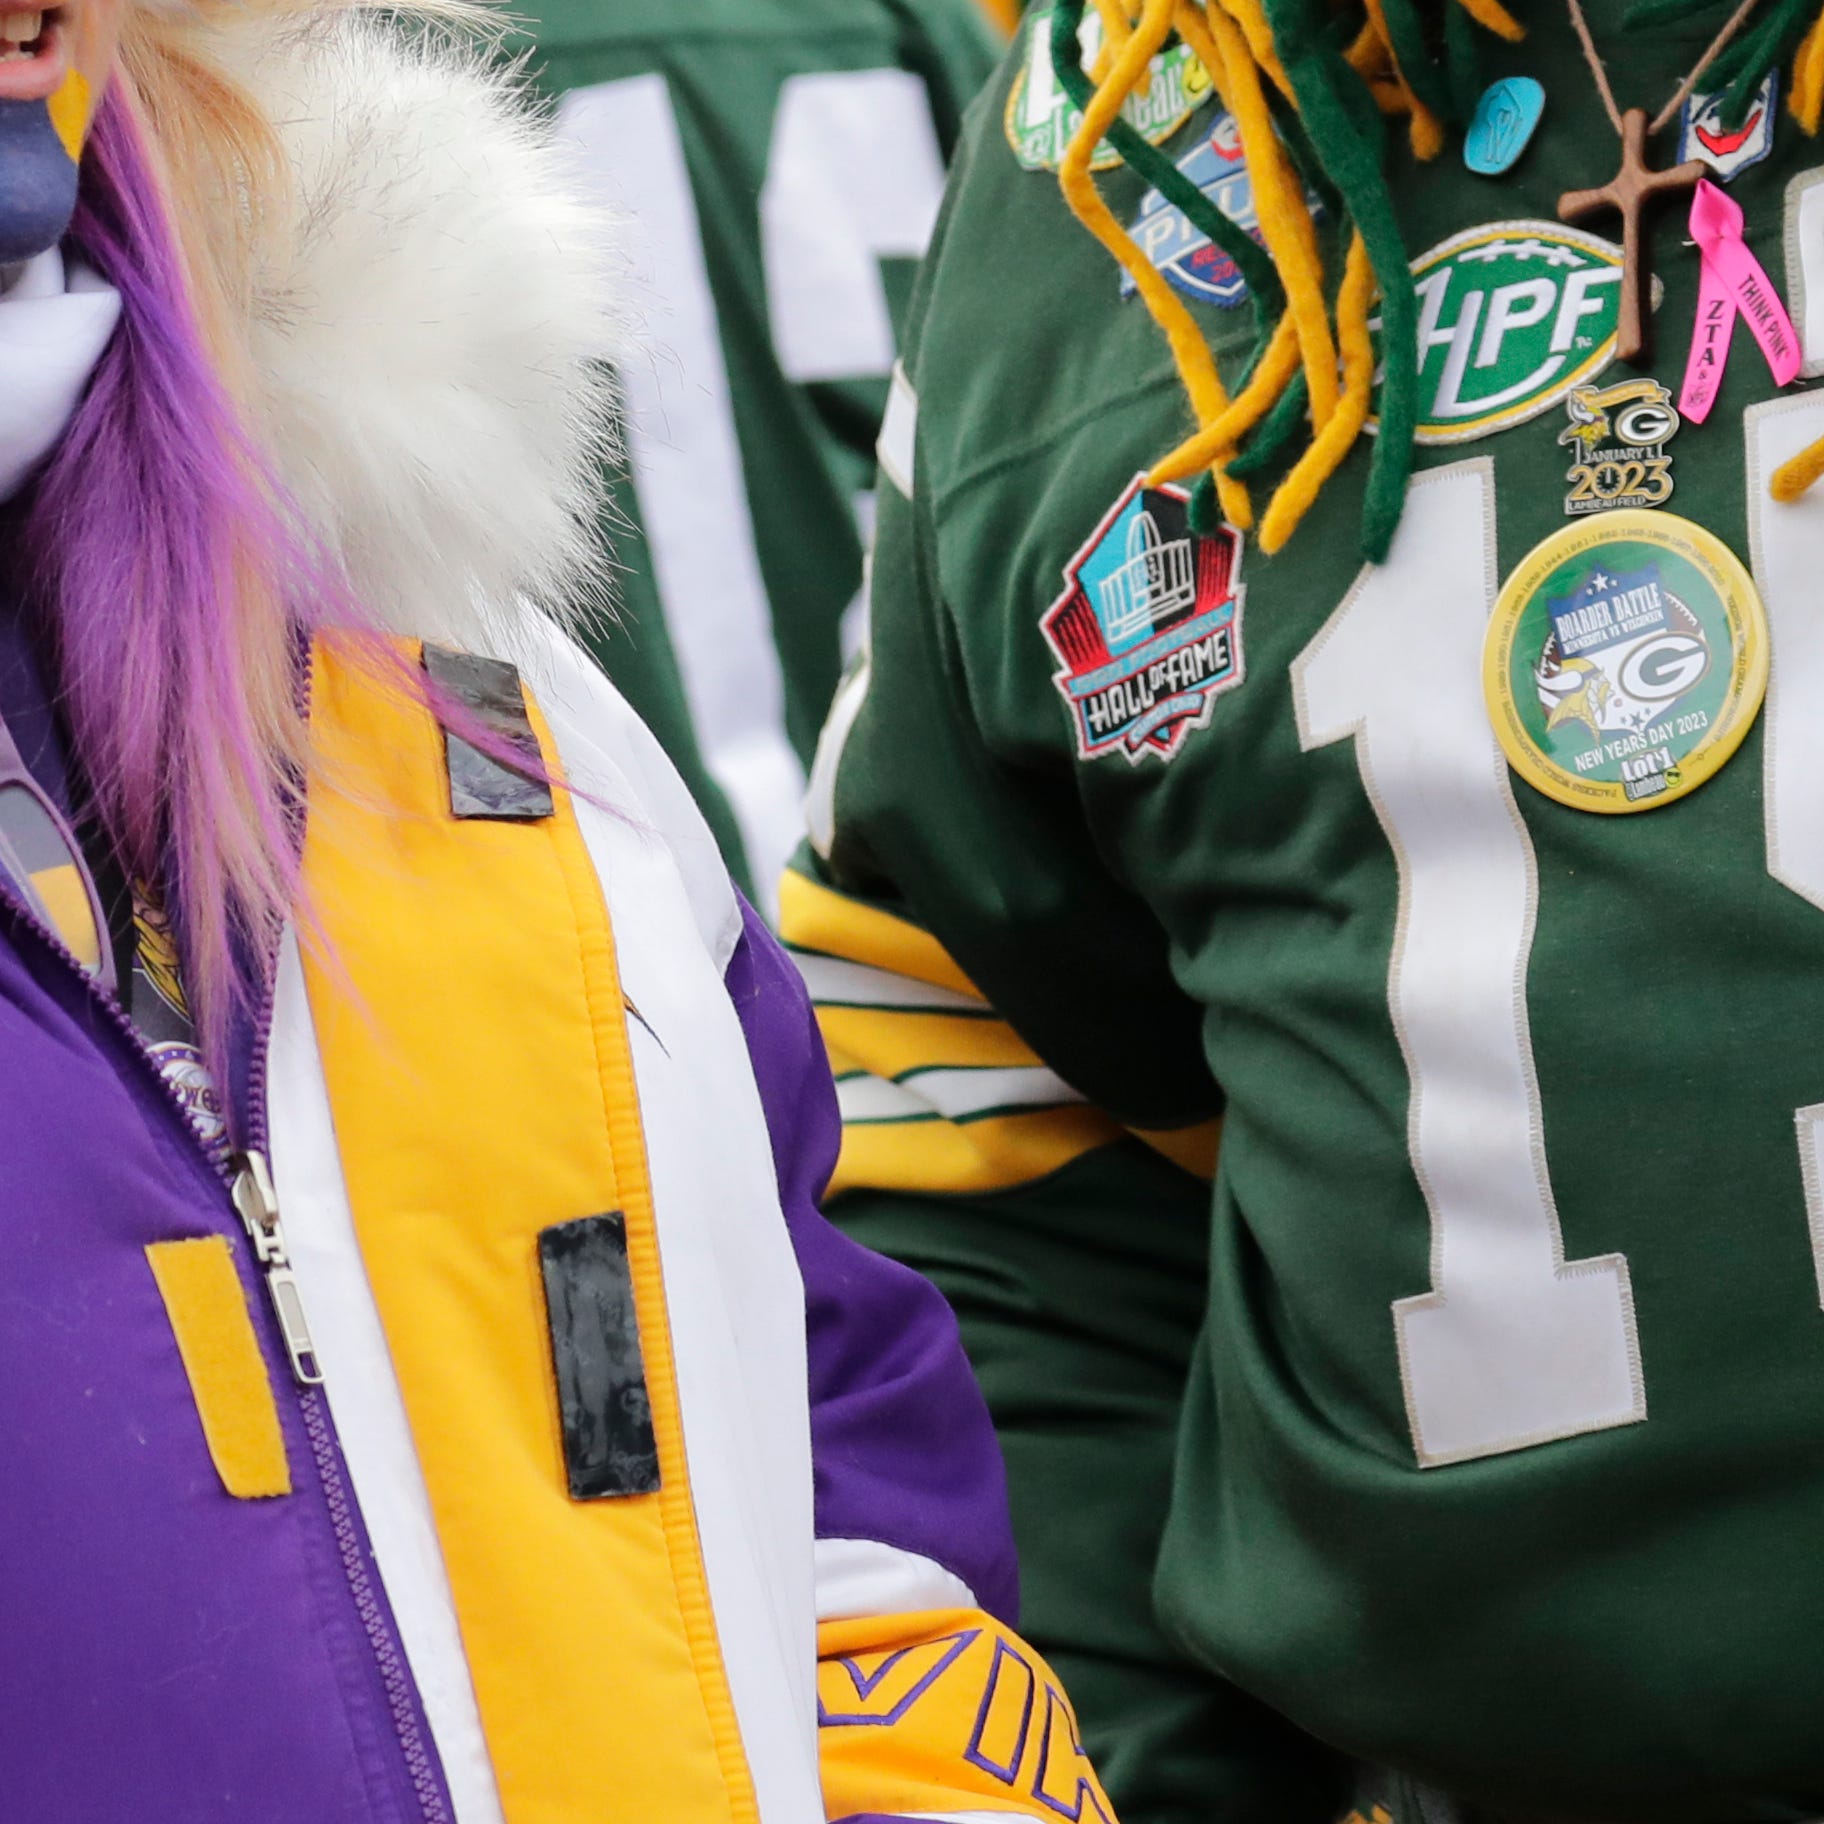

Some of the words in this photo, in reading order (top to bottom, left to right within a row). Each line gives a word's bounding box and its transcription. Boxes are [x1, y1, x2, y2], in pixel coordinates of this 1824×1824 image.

[1738, 273, 1775, 328] THINK
[1567, 459, 1672, 501] 2023
[1583, 447, 1645, 464] JANUARY
[1615, 495, 1647, 508] FIELD
[1555, 600, 1613, 643] BOARDER
[1612, 582, 1663, 622] BATTLE
[1088, 673, 1154, 733] HALL
[1148, 662, 1168, 691] OF
[1165, 628, 1228, 693] FAME
[1574, 745, 1605, 773] NEW
[1604, 732, 1648, 761] YEARS
[1649, 721, 1675, 746] DAY
[1677, 710, 1709, 736] 2023
